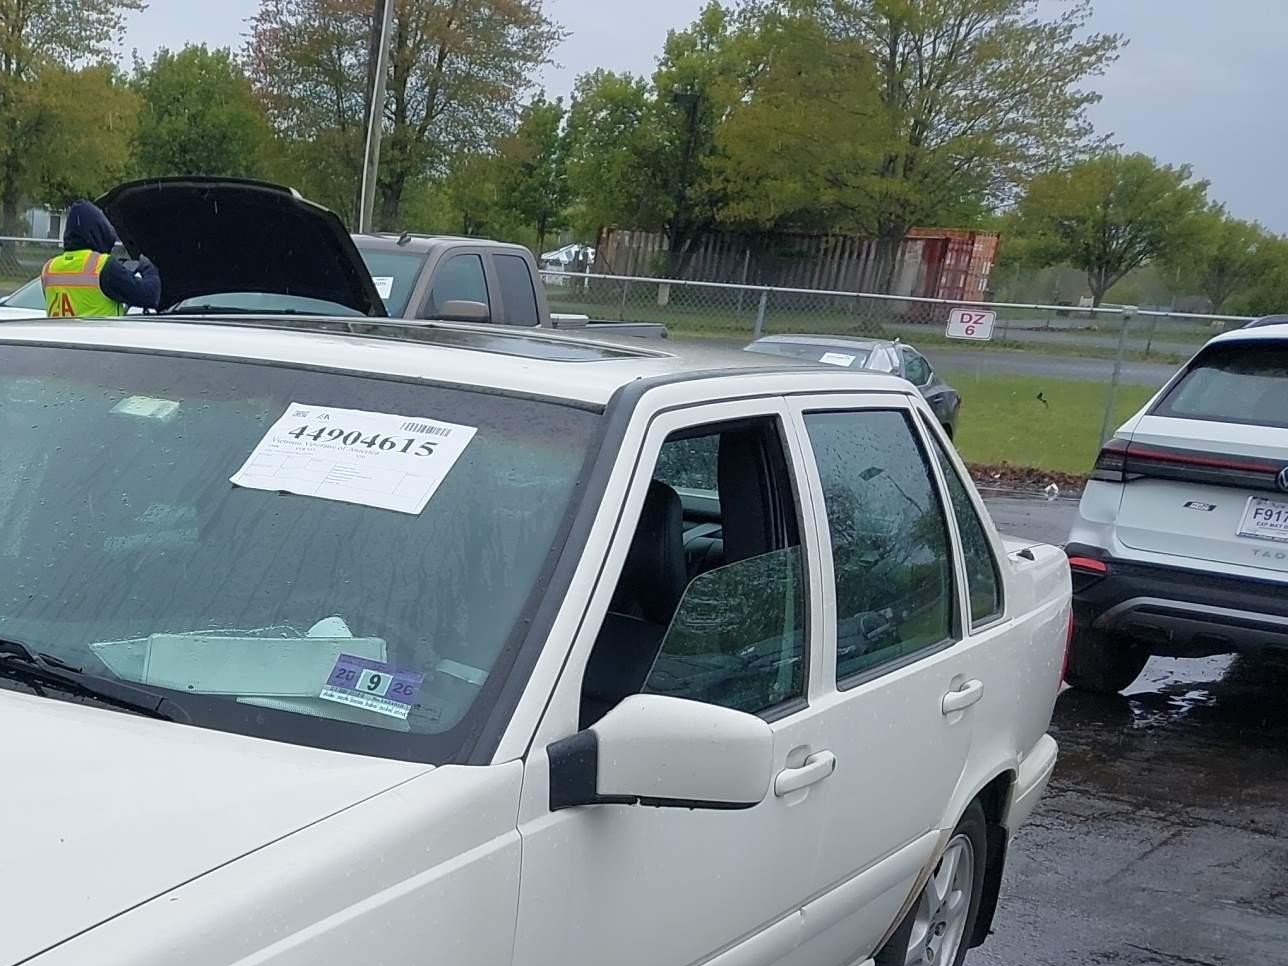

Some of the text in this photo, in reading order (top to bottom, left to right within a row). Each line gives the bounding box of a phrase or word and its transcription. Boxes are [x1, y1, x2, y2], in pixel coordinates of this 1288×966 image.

[960, 313, 986, 325] DZ
[965, 325, 976, 336] 6
[288, 424, 441, 457] 44904615
[367, 674, 382, 691] 9
